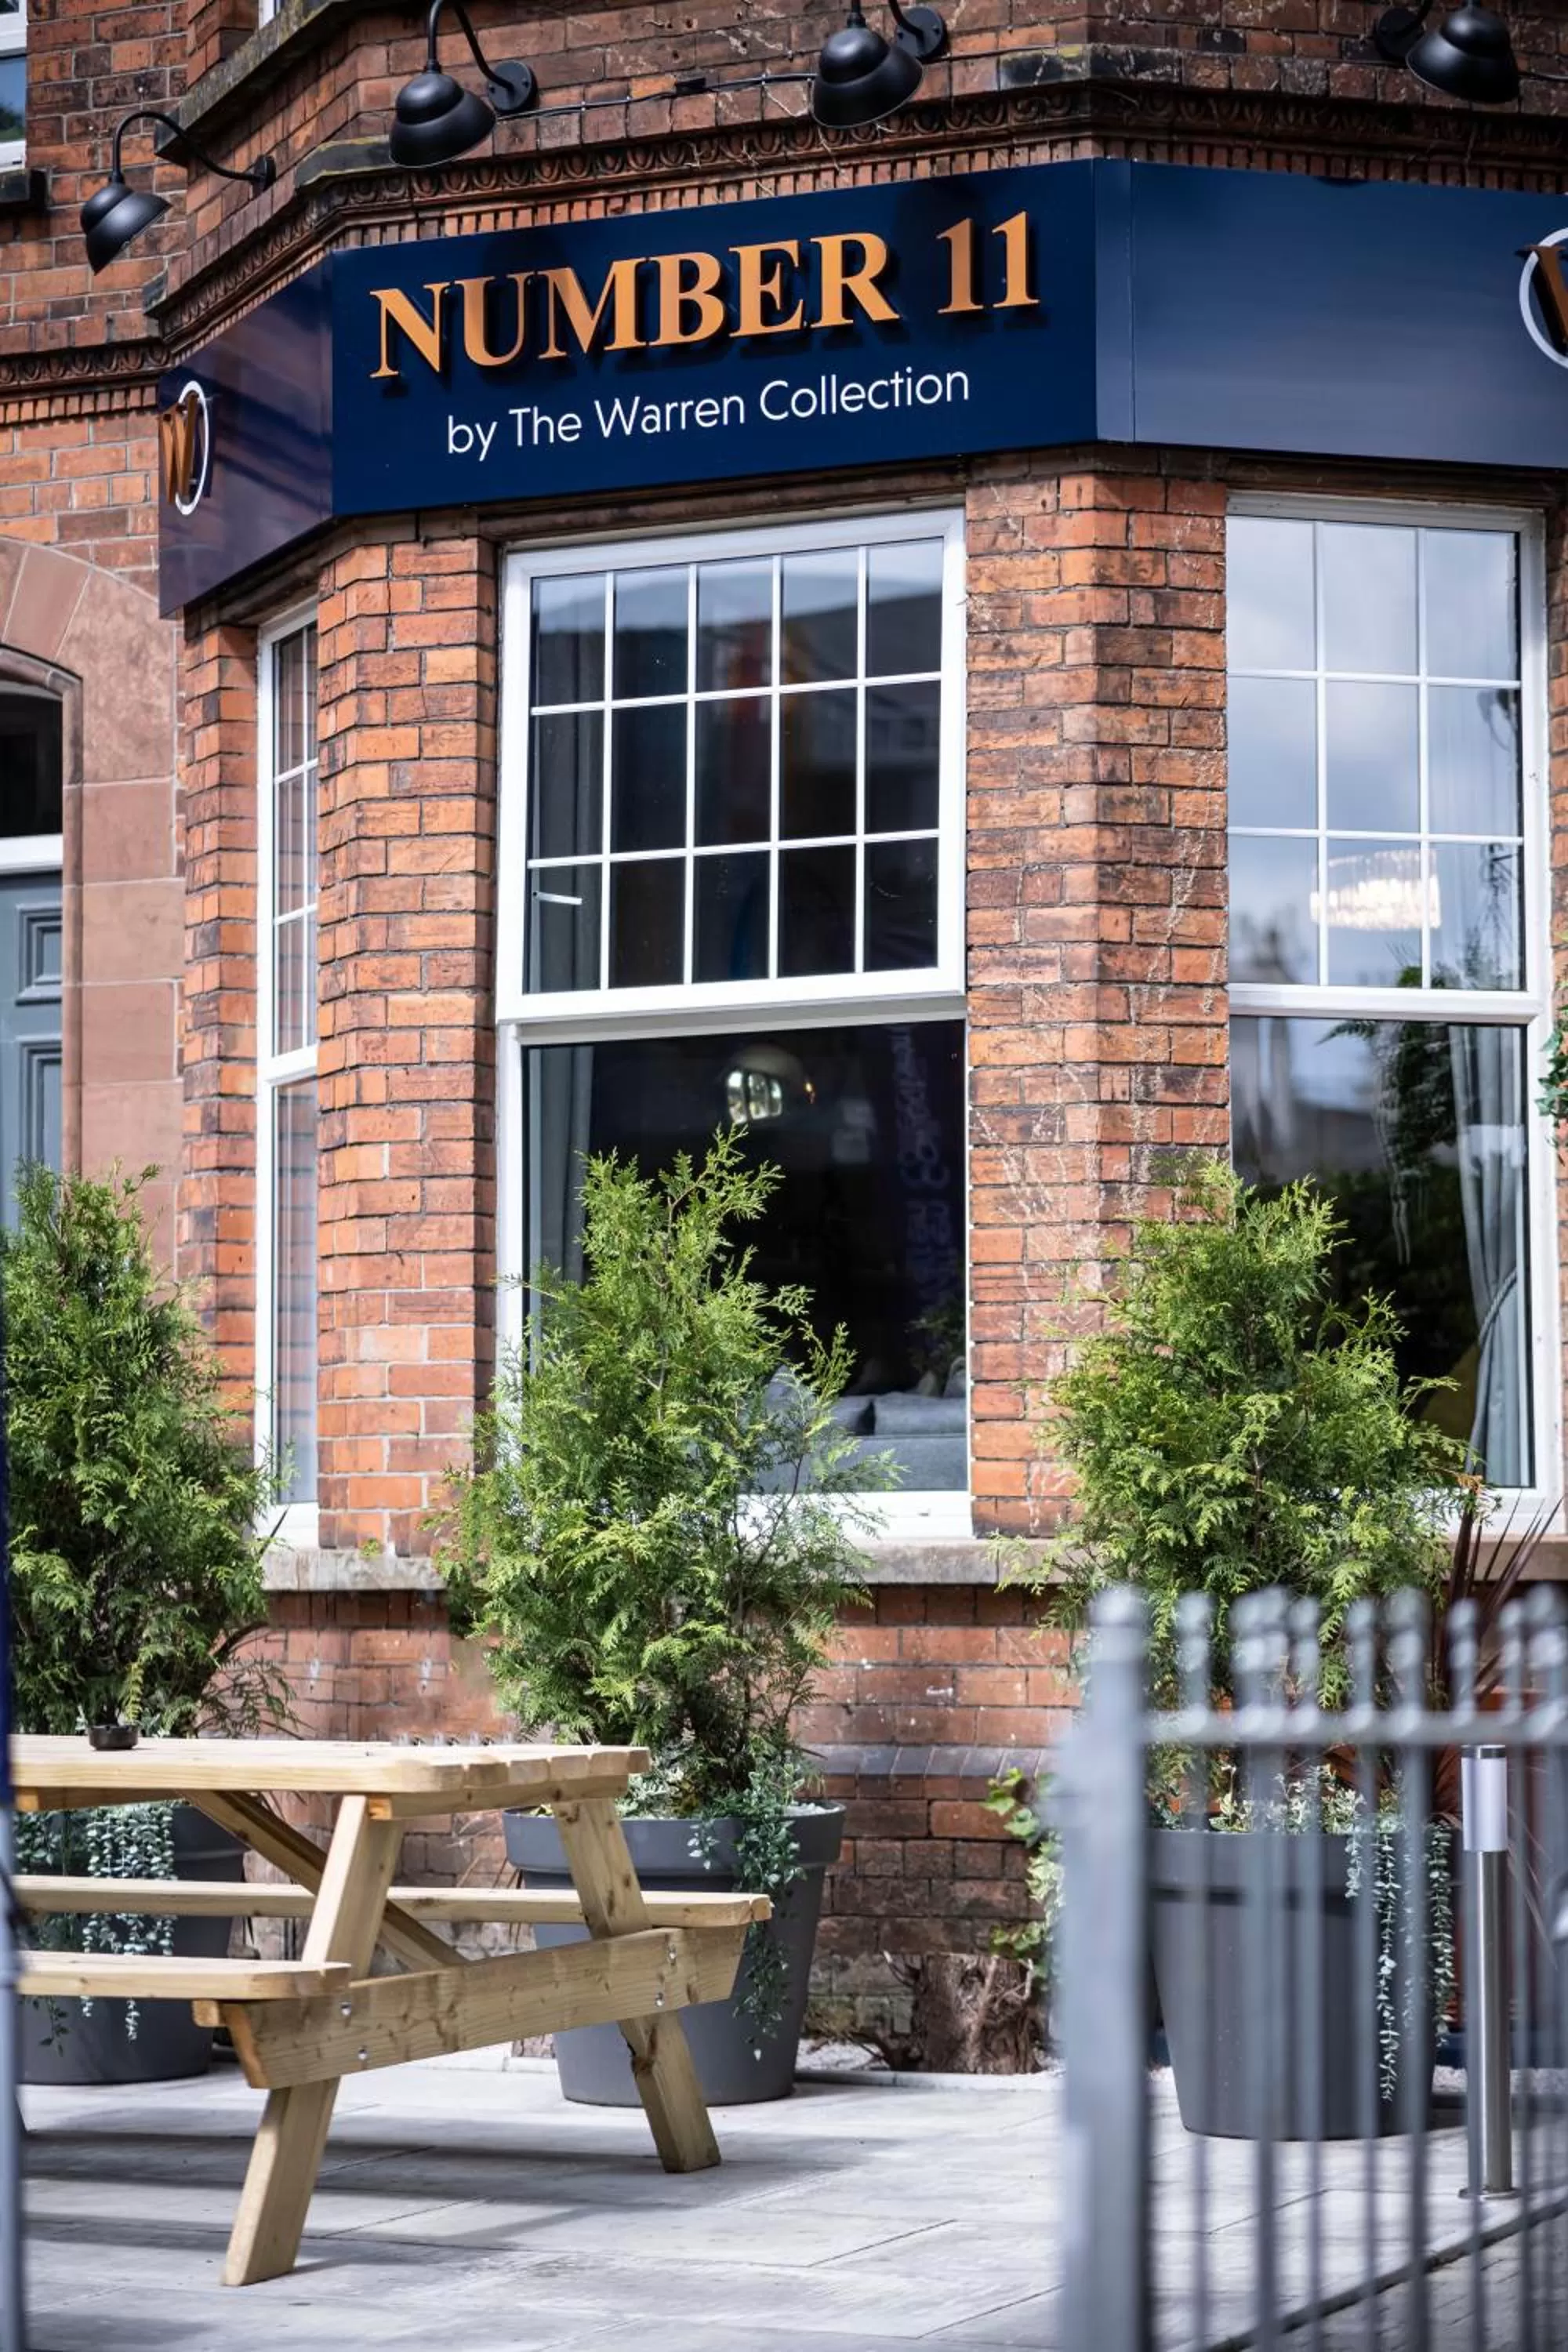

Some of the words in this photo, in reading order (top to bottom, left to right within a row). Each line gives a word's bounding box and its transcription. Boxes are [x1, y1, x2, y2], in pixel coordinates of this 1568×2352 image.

[369, 232, 899, 379] NUMBER
[937, 211, 1040, 314] 11
[447, 414, 498, 461] by
[509, 405, 583, 447] The
[594, 395, 746, 437] Warren
[759, 366, 970, 421] Collection
